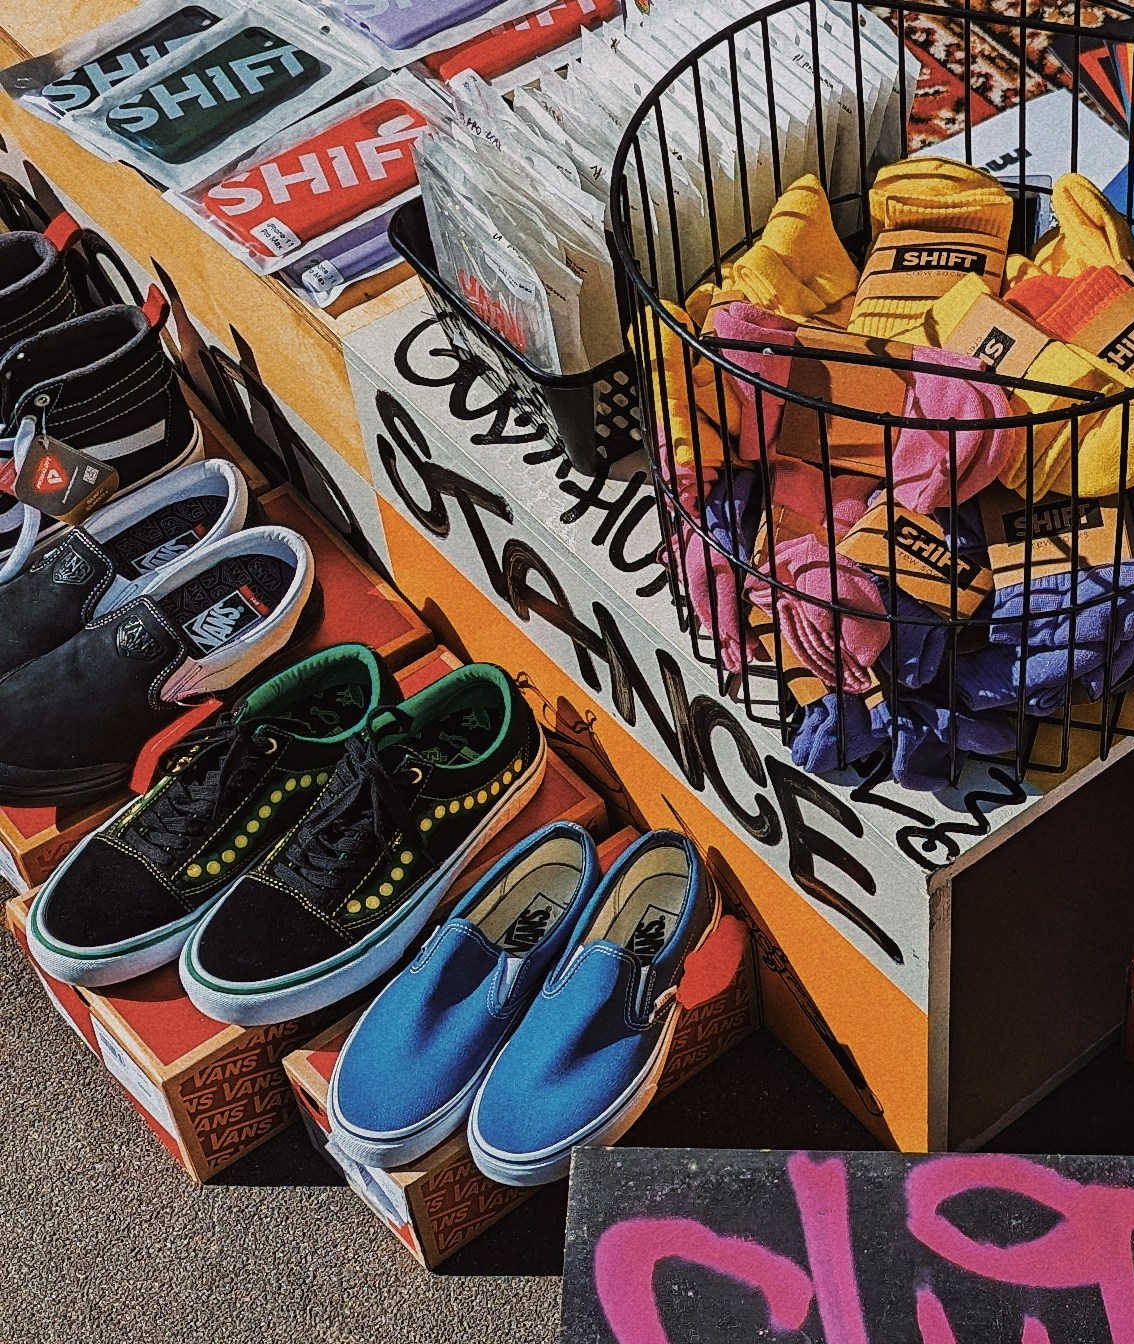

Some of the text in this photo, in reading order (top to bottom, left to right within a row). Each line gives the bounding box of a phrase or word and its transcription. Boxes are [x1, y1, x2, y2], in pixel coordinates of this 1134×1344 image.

[106, 47, 306, 134] SHIFT
[902, 250, 978, 269] SHIFT
[896, 526, 972, 578] SHIFT
[375, 387, 905, 967] STANCE
[189, 1049, 261, 1088] VANS
